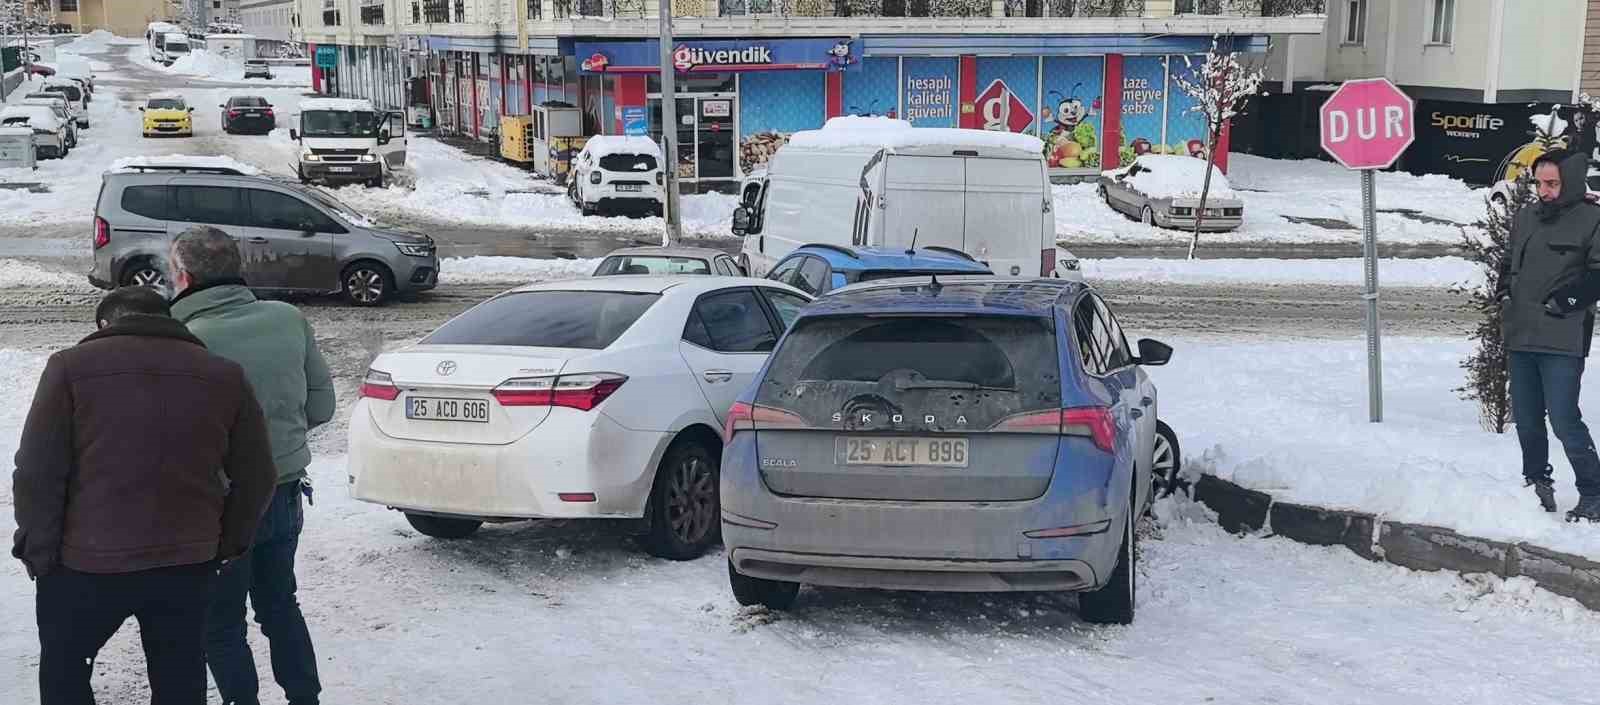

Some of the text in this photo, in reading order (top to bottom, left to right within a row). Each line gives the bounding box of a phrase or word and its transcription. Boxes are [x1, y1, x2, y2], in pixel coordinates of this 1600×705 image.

[674, 46, 771, 69] güvendik
[907, 74, 951, 93] hesaplı
[1123, 77, 1149, 90] taze
[907, 90, 950, 105] kaliteli
[1122, 89, 1162, 104] meyve
[907, 105, 952, 122] güvenli
[1121, 101, 1155, 115] sebze
[1329, 105, 1404, 143] DUR
[1431, 111, 1505, 131] Sporlife
[414, 399, 486, 419] 25 ACD 606
[848, 439, 966, 464] 25 ACT 896
